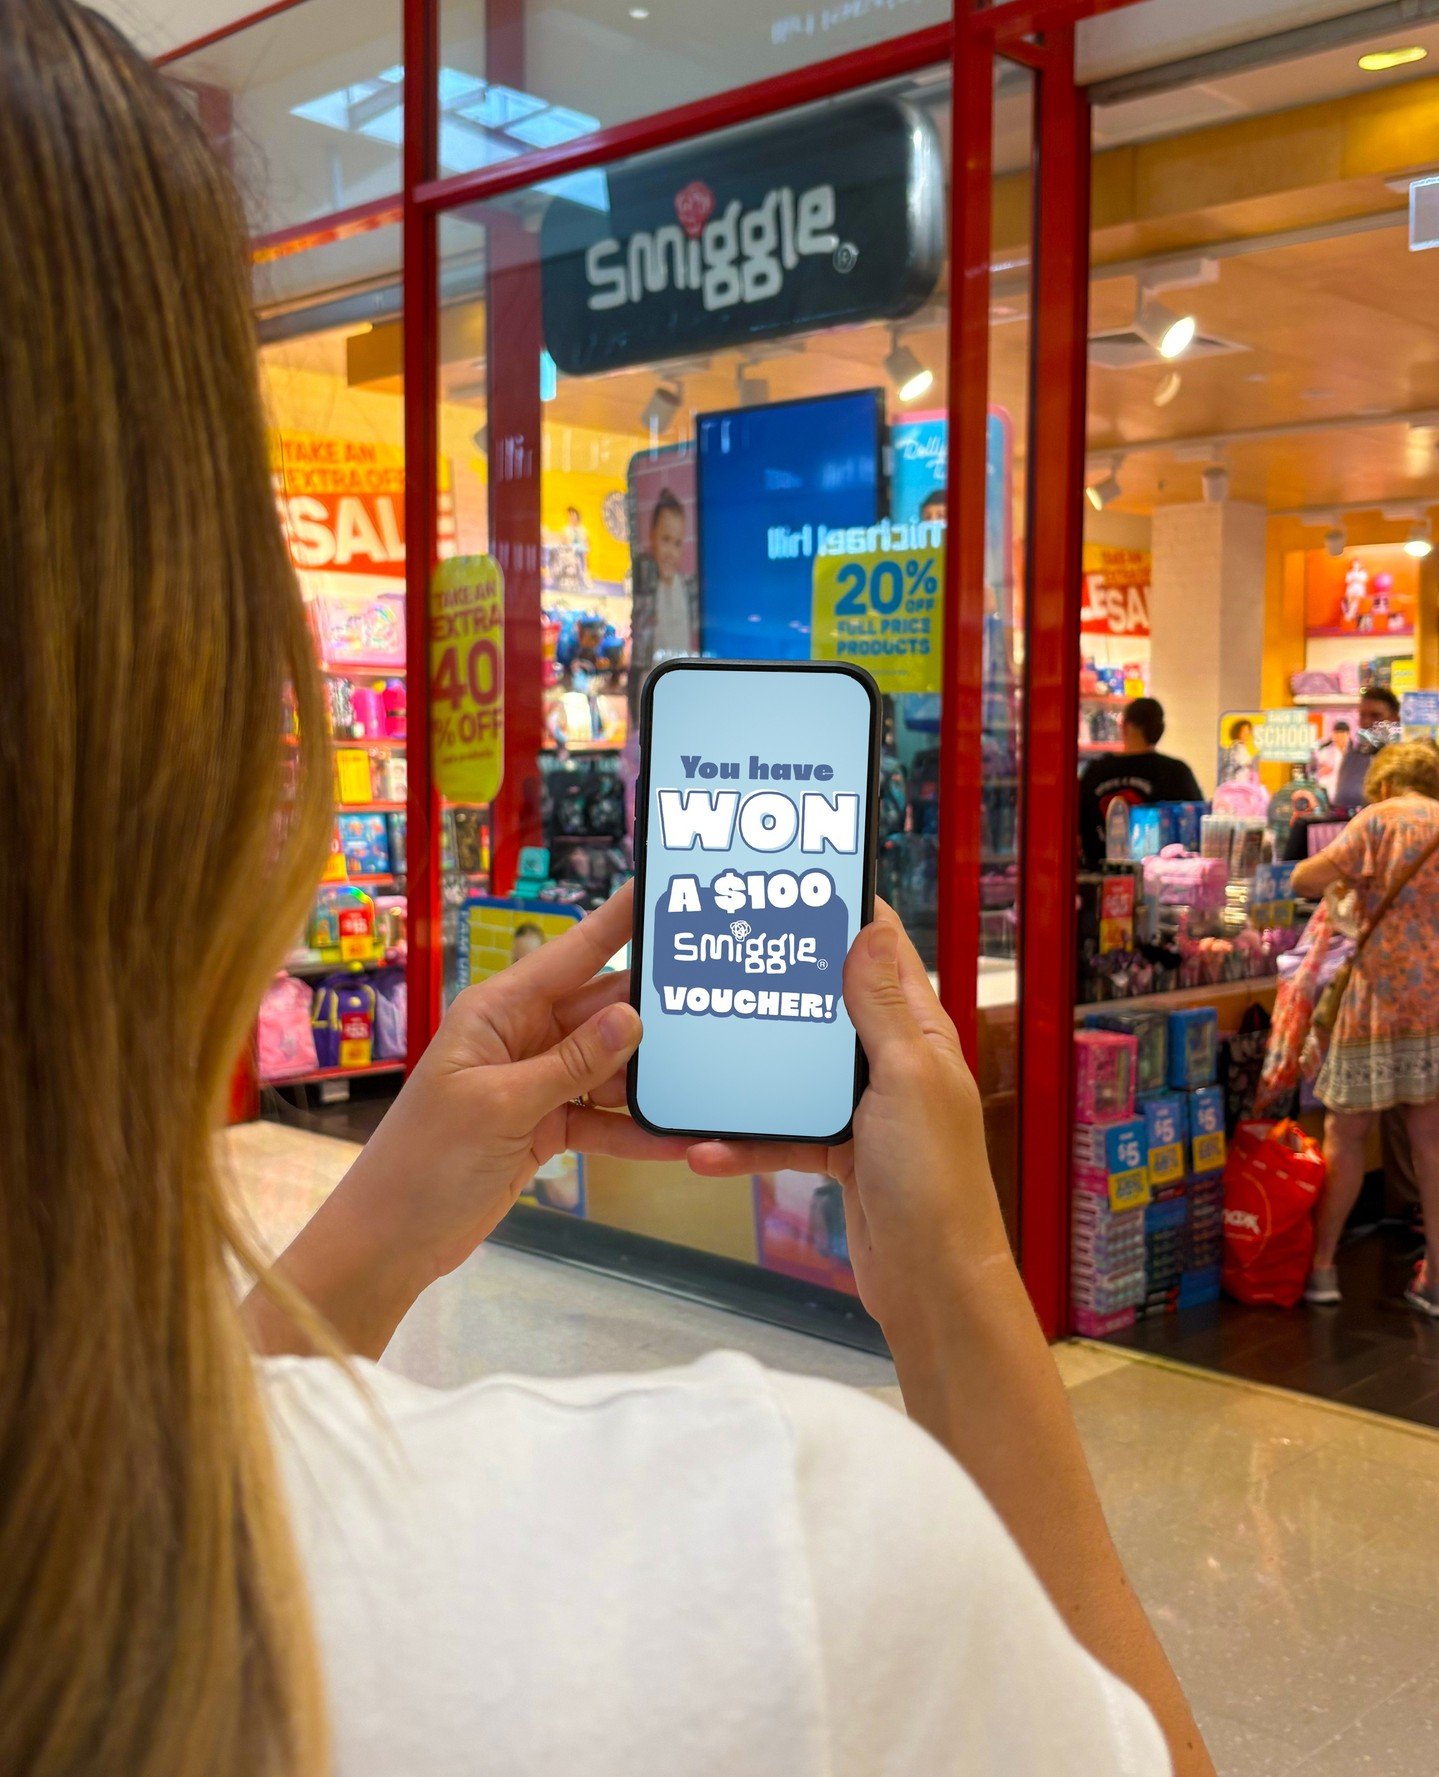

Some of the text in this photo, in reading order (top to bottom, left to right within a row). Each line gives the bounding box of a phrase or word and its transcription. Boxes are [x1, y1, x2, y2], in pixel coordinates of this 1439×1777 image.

[285, 440, 339, 463] TAKE
[905, 598, 935, 614] OFF
[881, 618, 931, 634] PRICE
[837, 639, 931, 656] PRODUCTS
[432, 637, 499, 711] 40
[680, 755, 835, 782] You have
[656, 788, 860, 855] WON
[667, 871, 832, 914] A $100
[663, 985, 834, 1019] VOUCHER!
